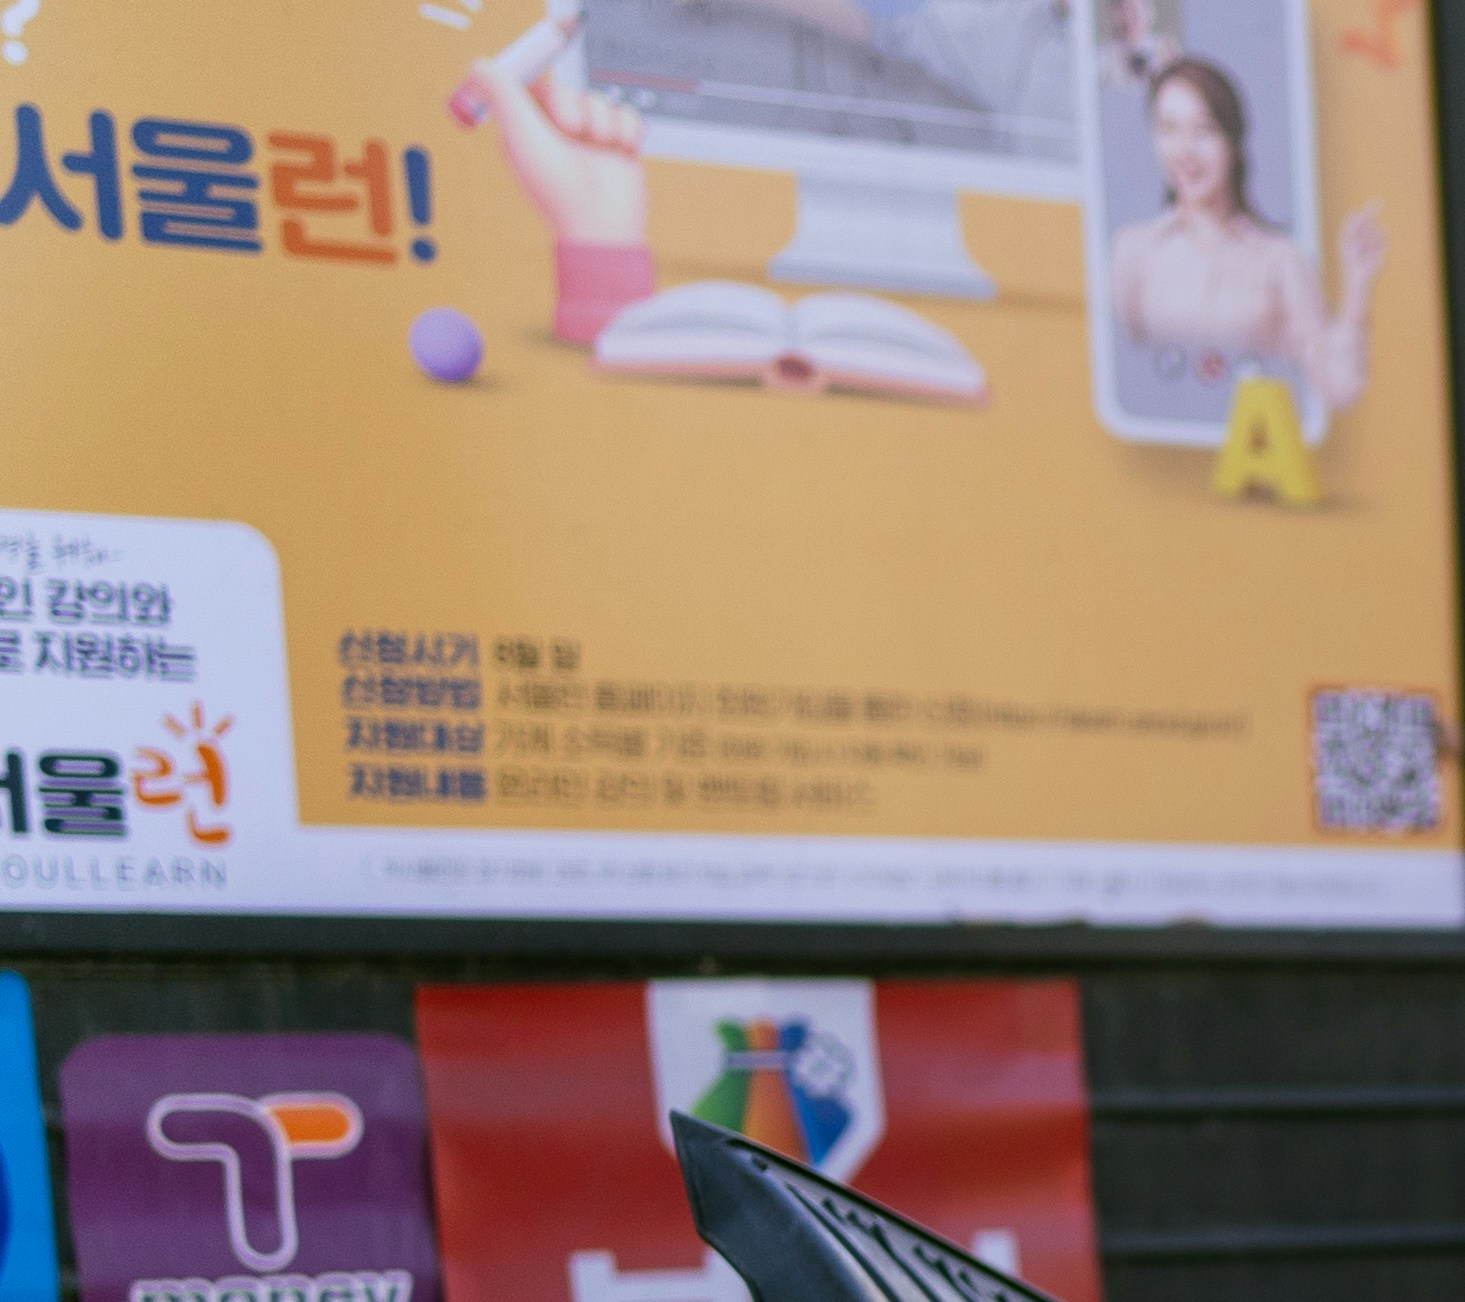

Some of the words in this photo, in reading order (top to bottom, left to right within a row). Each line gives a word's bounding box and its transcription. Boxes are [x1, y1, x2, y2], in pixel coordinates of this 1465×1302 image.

[0, 103, 438, 267] 서울런!
[46, 577, 172, 627] 강의와
[34, 629, 198, 681] 지원하는
